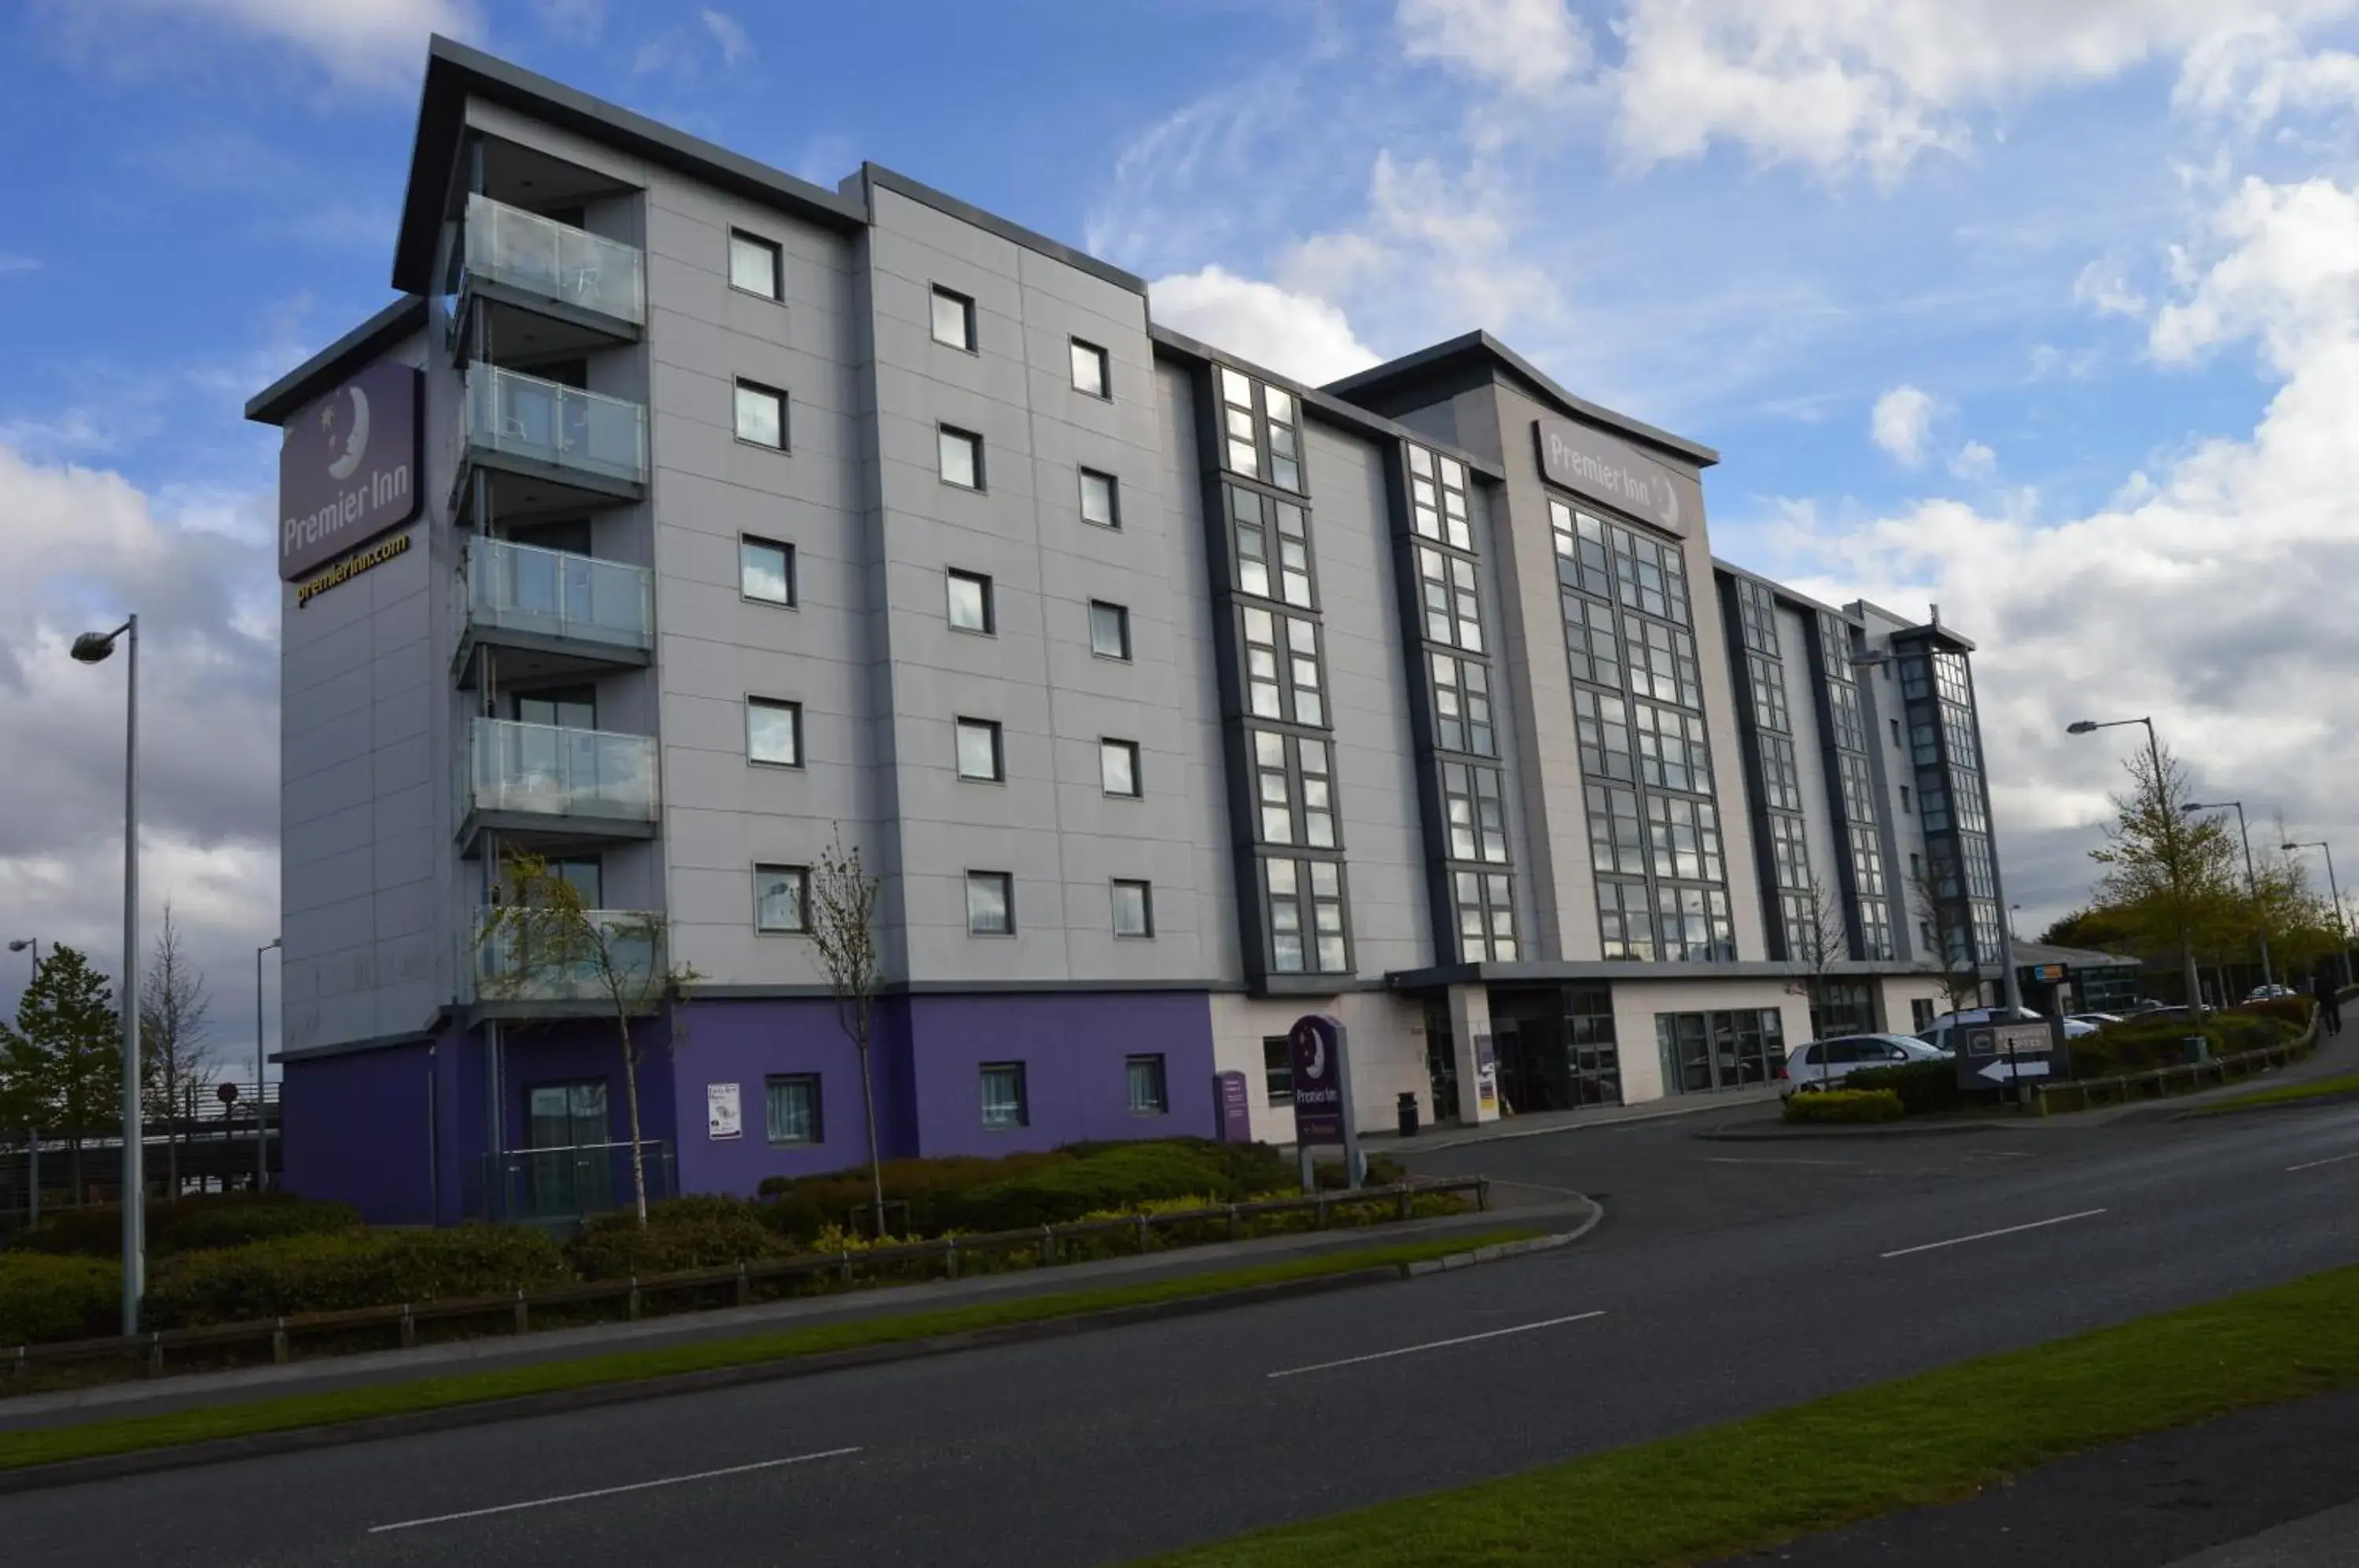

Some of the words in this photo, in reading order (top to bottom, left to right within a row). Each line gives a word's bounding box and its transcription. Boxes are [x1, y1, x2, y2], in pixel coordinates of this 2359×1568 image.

[1550, 433, 1620, 491] Premier
[1624, 466, 1651, 507] Inn
[284, 484, 370, 557] Premier
[372, 464, 408, 510] Inn
[297, 535, 410, 608] premierinn.com
